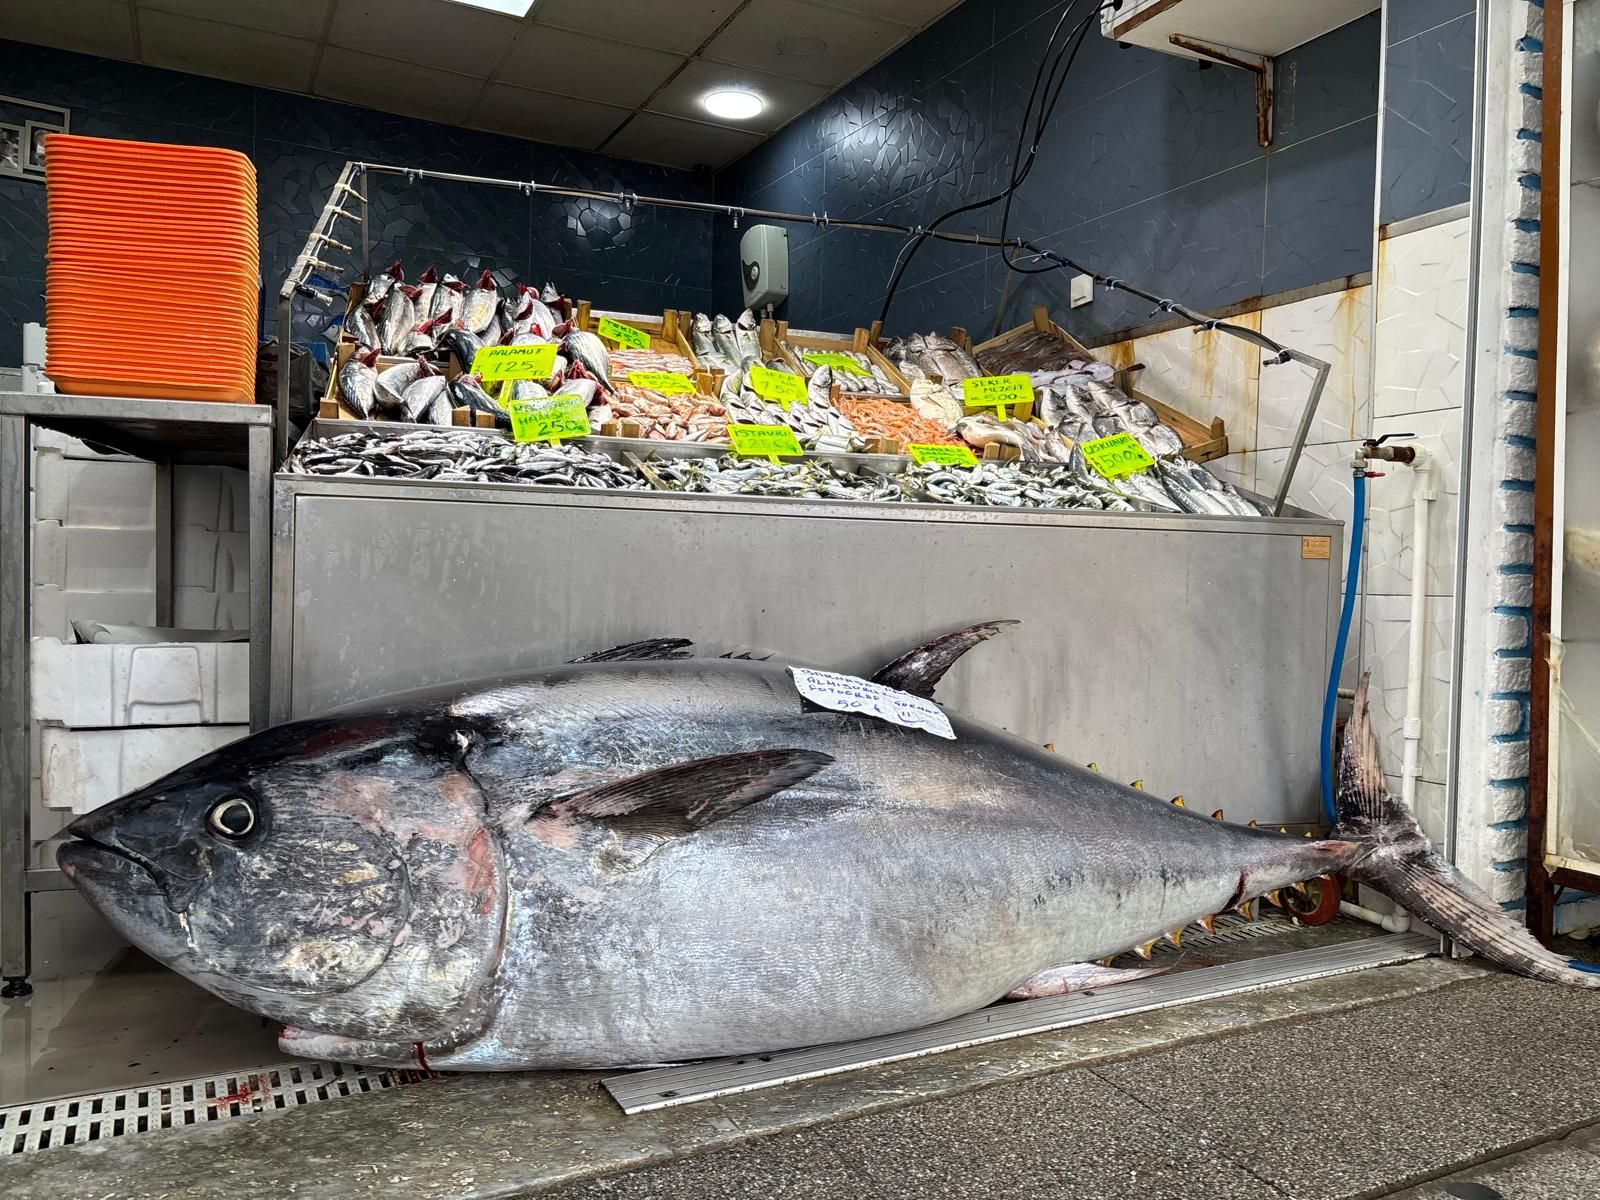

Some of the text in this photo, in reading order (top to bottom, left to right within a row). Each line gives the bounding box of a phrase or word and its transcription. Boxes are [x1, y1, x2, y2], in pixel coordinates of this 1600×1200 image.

[489, 348, 543, 358] PALAMUT
[494, 360, 534, 374] 125
[984, 393, 1018, 401] 500
[538, 420, 578, 436] 250
[837, 700, 862, 708] 50
